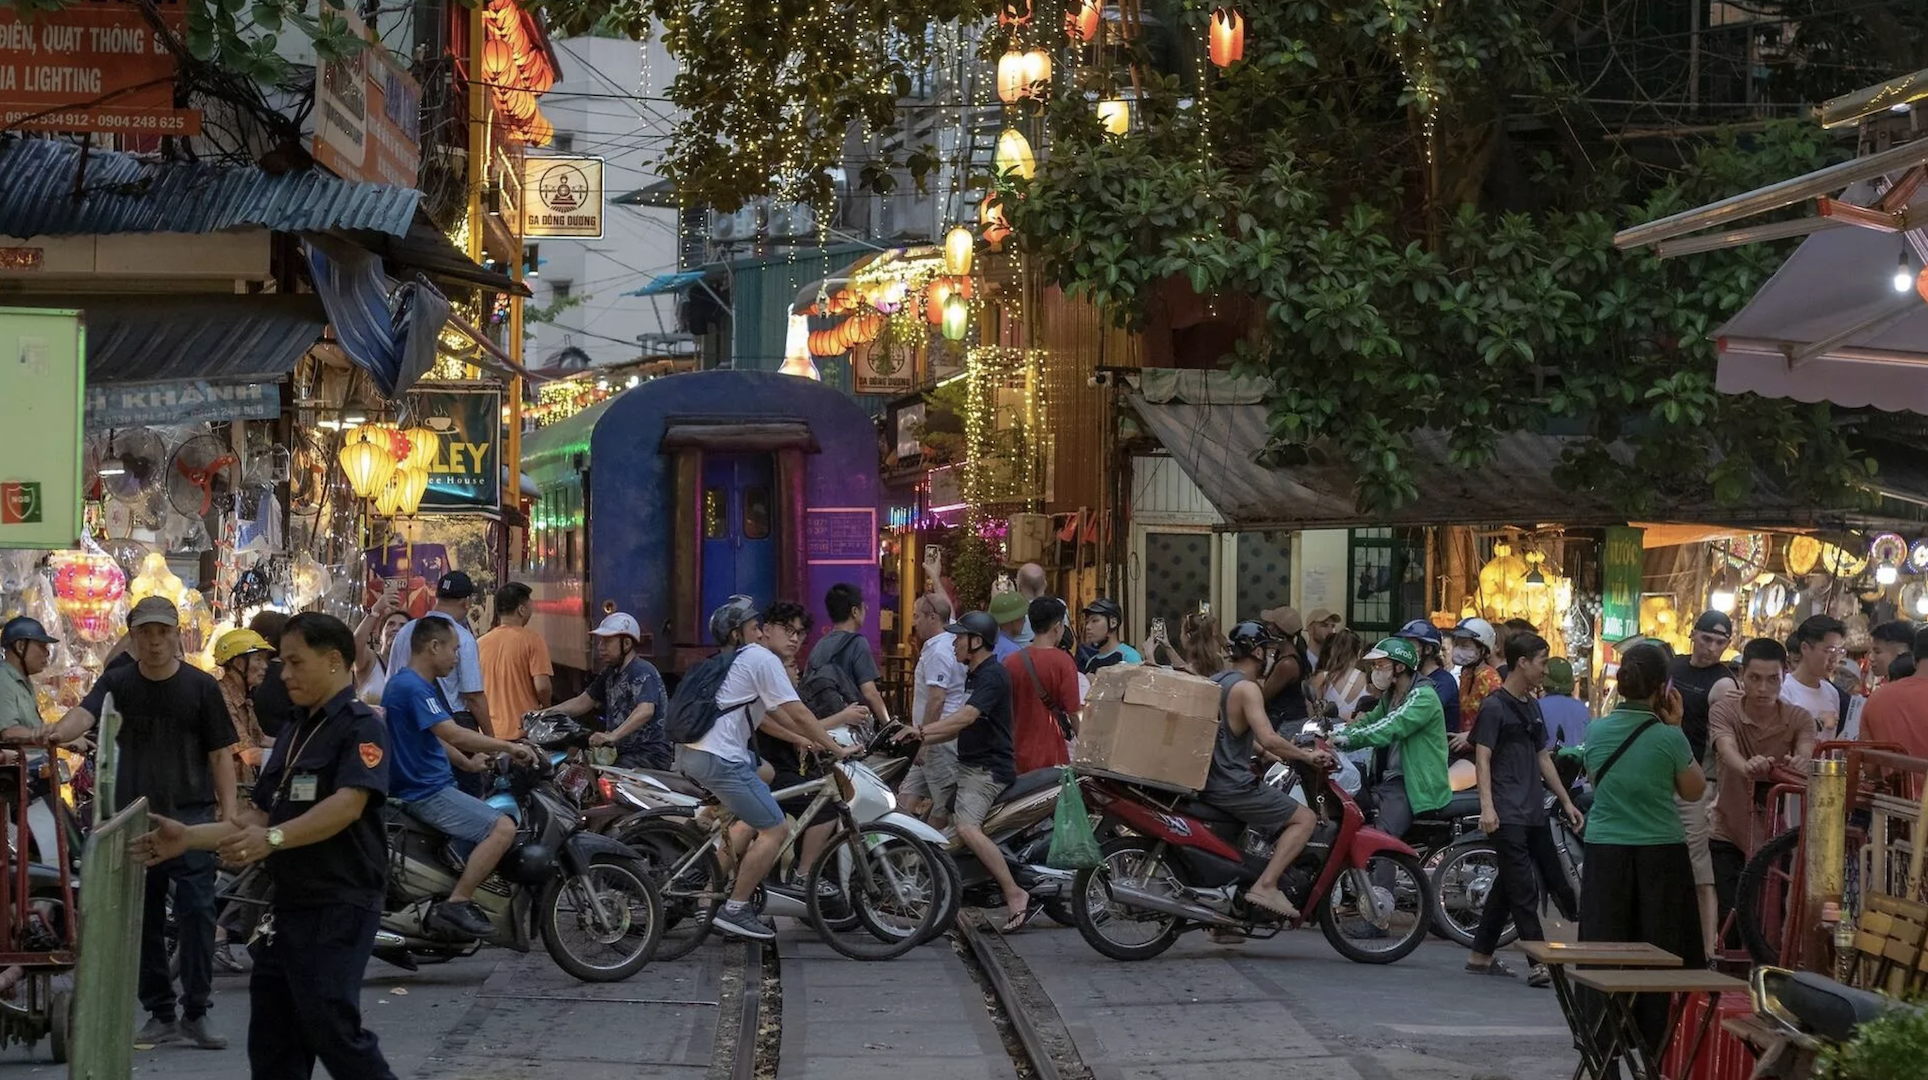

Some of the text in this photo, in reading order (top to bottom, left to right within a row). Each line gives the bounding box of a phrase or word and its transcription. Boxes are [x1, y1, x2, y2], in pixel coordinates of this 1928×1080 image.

[42, 24, 84, 55] QUẠT
[89, 23, 145, 54] THÔNG
[24, 65, 101, 93] LIGHTING
[40, 112, 64, 125] 534
[65, 113, 88, 126] 912
[98, 114, 130, 127] 0904
[132, 115, 156, 128] 248
[159, 116, 184, 129] 625
[528, 215, 540, 225] GA
[428, 442, 489, 474] LEY
[447, 476, 485, 484] House
[1394, 647, 1413, 659] Grab
